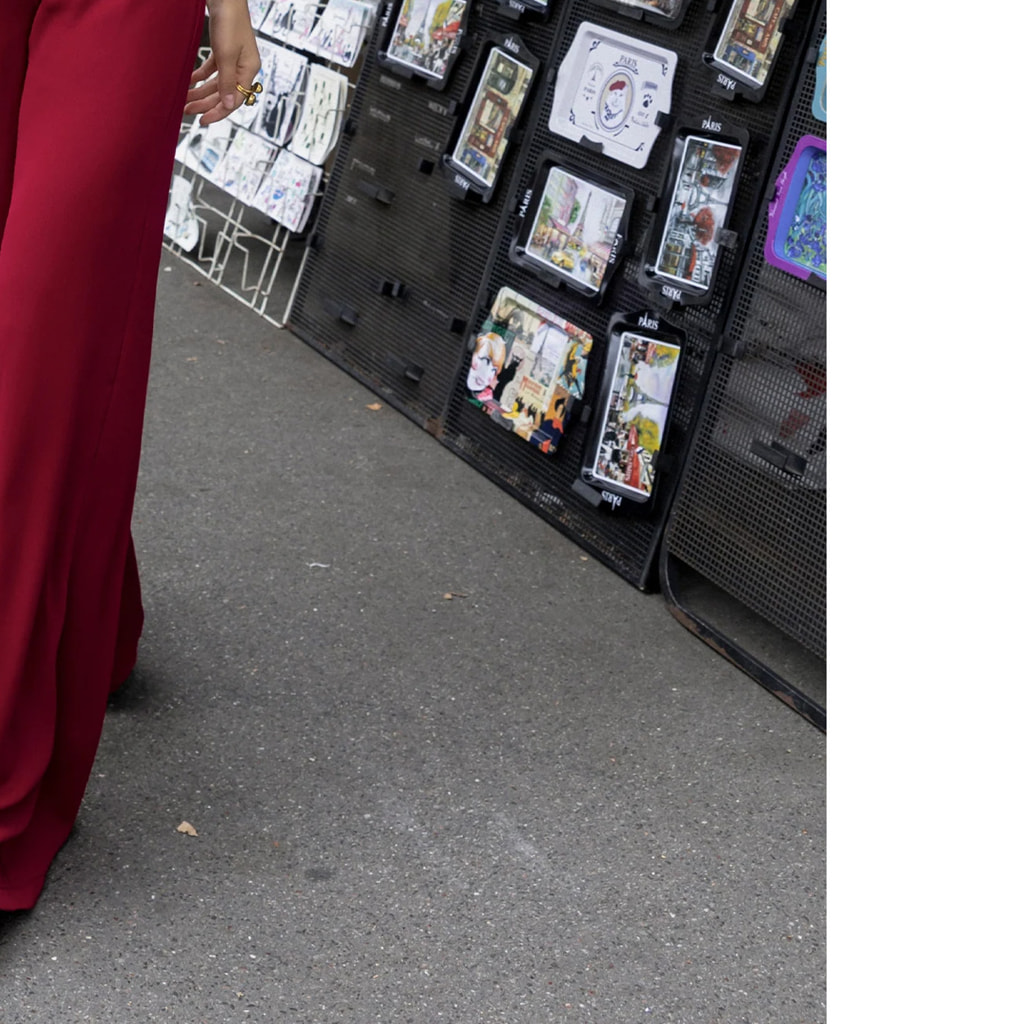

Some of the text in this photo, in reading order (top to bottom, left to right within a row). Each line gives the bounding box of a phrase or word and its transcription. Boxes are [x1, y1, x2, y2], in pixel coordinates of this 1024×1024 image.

[382, 2, 393, 27] PARIS
[504, 36, 520, 53] PARIS
[619, 54, 638, 67] PARIS
[702, 115, 722, 132] PARIS
[519, 189, 533, 217] PARIS
[638, 312, 659, 330] PARIS
